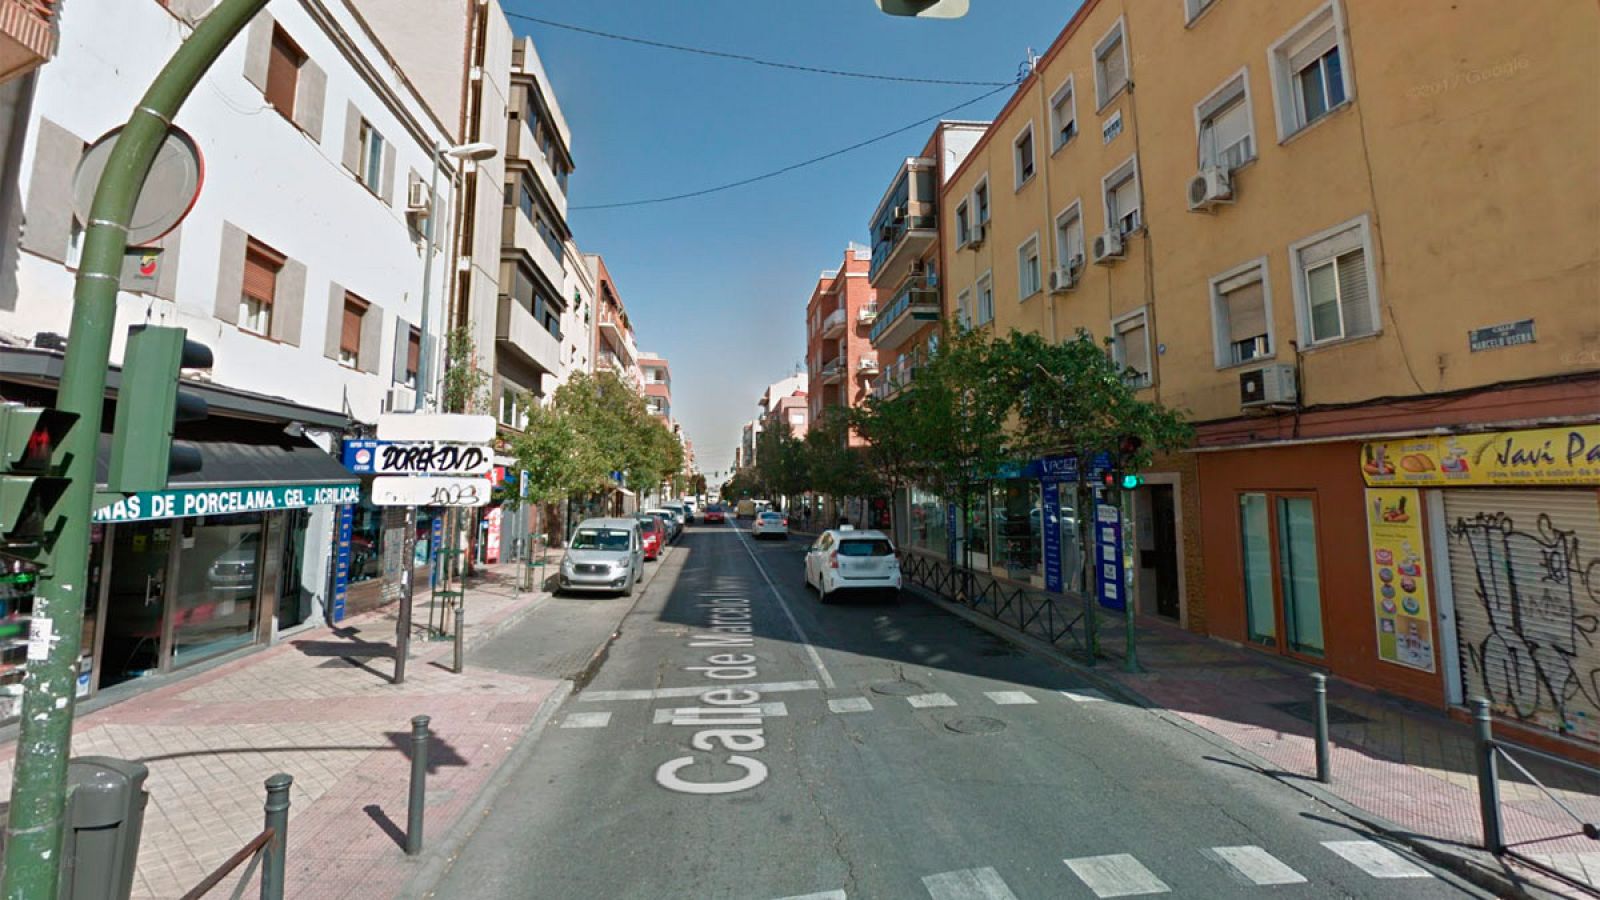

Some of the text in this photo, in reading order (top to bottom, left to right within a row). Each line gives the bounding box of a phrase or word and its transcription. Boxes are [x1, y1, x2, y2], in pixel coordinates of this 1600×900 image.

[1495, 437, 1555, 468] Javi
[151, 495, 175, 517] DE
[183, 491, 274, 514] PORCELANA
[284, 489, 306, 507] GEL
